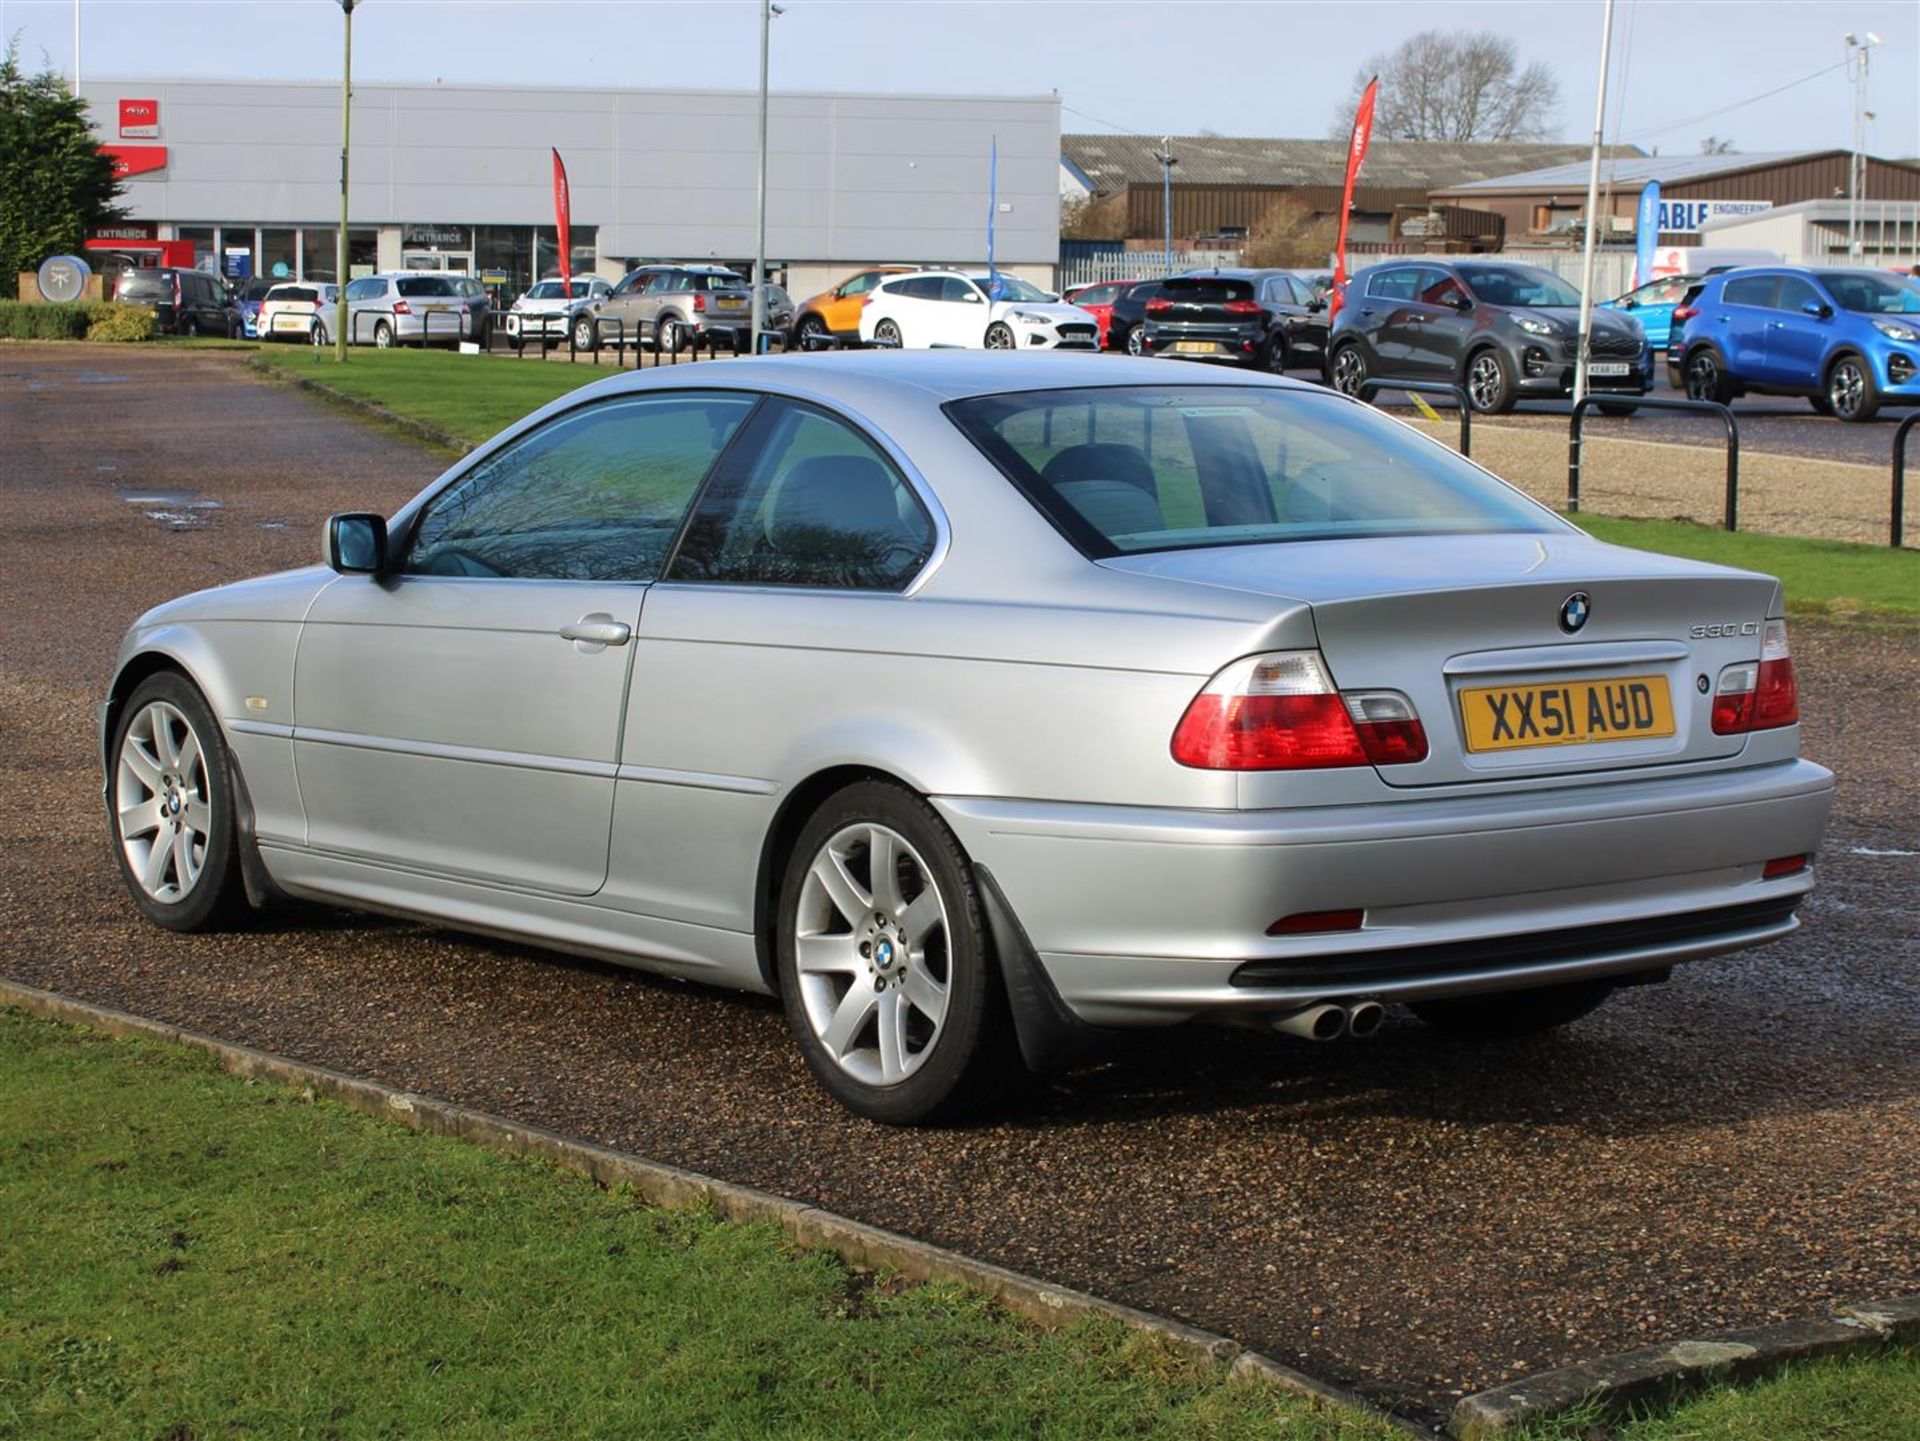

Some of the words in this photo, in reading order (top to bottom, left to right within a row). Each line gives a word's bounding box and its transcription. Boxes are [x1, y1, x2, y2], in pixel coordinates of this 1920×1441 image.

[97, 228, 148, 239] ENTRANCE
[412, 233, 461, 243] ENTRANCE
[1689, 624, 1737, 640] 330
[1486, 688, 1576, 742] XX51
[1587, 683, 1655, 733] AUD
